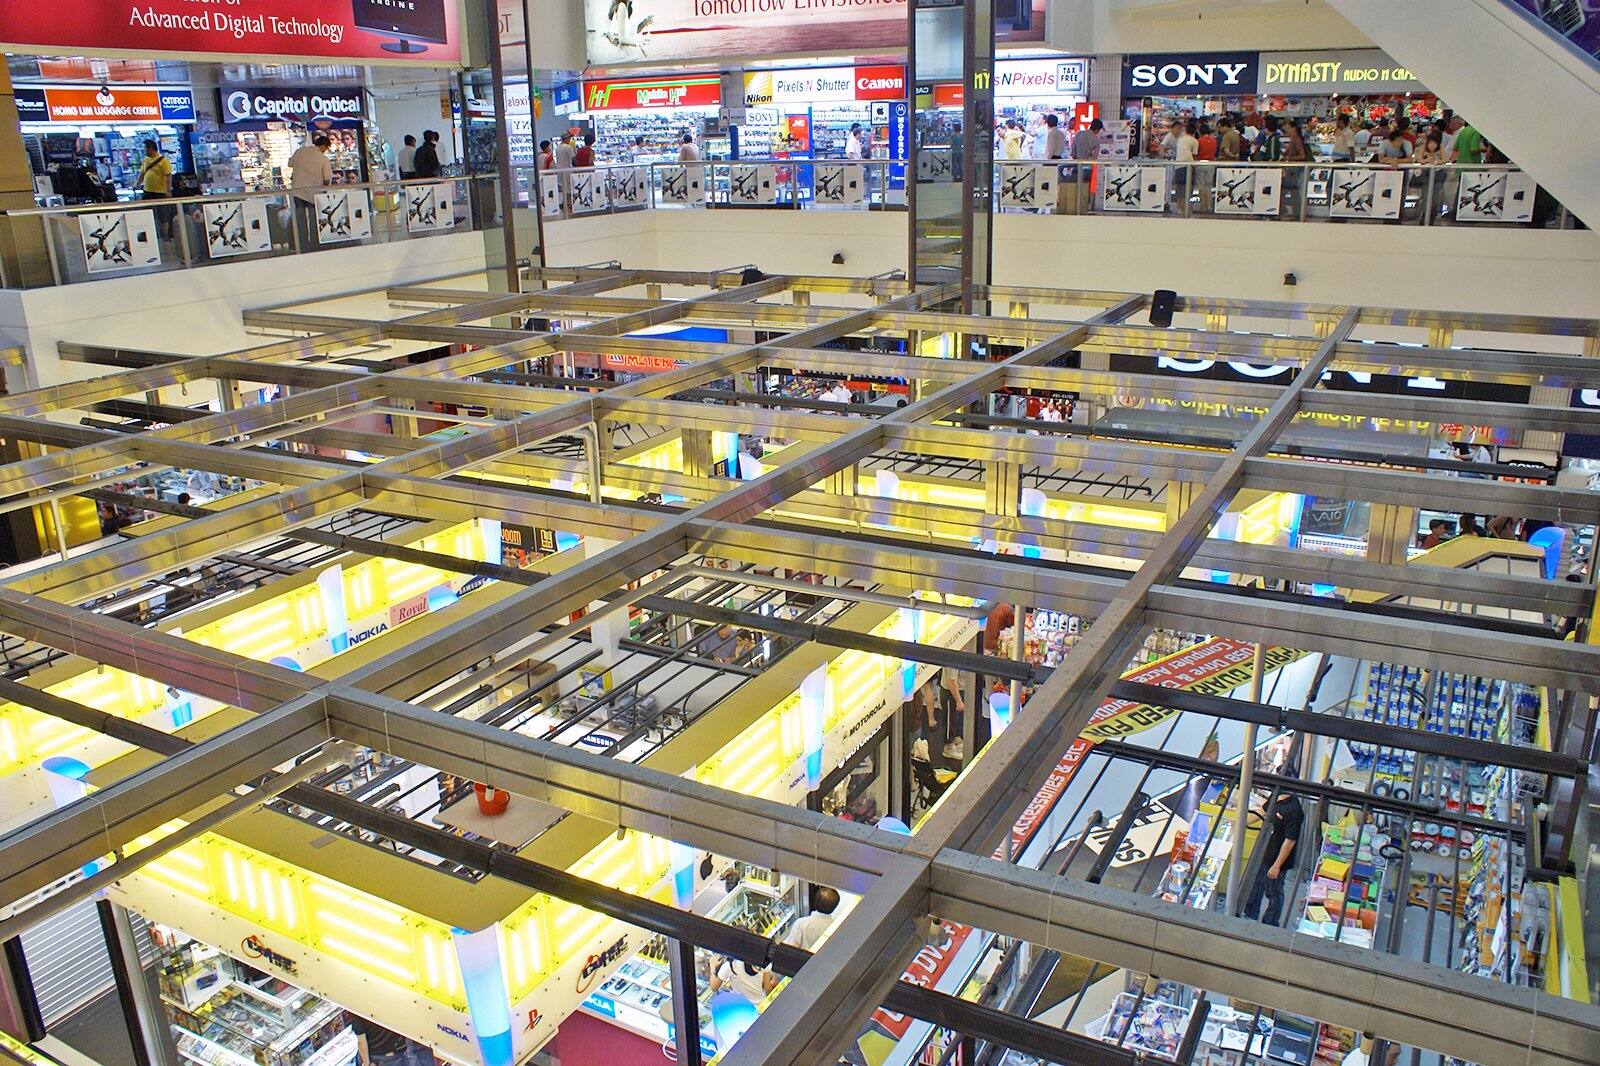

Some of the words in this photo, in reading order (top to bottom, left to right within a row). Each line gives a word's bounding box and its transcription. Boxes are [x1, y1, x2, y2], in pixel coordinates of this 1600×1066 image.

[129, 7, 209, 31] Advanced
[215, 12, 264, 38] Digital
[271, 16, 344, 43] Technology
[857, 76, 903, 90] Canon
[1060, 74, 1078, 83] FREE
[1131, 63, 1247, 87] SONY
[1265, 62, 1342, 84] DYNASTY
[1343, 68, 1379, 82] AUDIO
[777, 79, 803, 92] Pixels
[806, 79, 813, 91] N
[816, 78, 850, 91] Shutter
[254, 95, 308, 117] Capitol
[311, 95, 360, 116] Optical
[746, 94, 773, 103] Nikon
[94, 106, 131, 117] LUGGAGE
[132, 106, 159, 116] CENTRE
[748, 113, 774, 123] SONY
[398, 596, 428, 621] Royal
[349, 622, 388, 647] NOKIA
[849, 699, 886, 736] MOTOROLA
[436, 1023, 470, 1043] NOKIA
